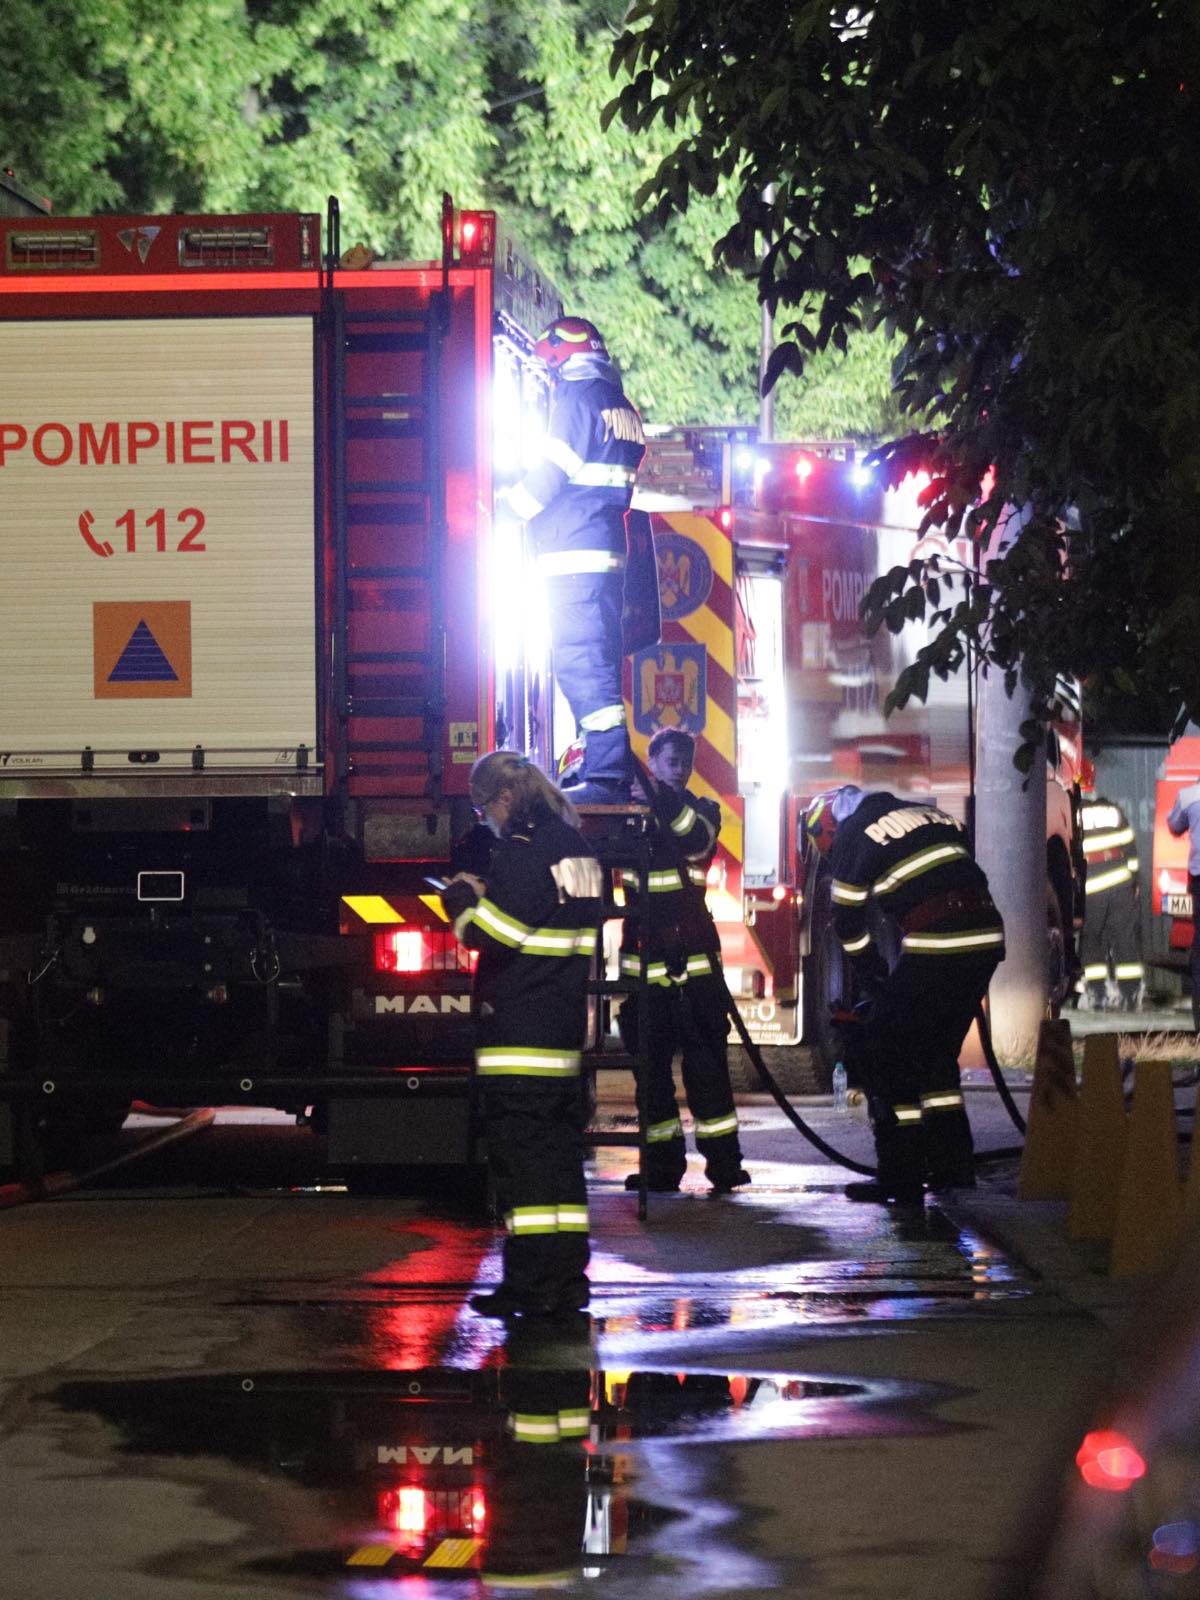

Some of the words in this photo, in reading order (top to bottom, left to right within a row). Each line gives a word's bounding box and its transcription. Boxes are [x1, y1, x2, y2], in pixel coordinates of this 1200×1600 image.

[115, 508, 206, 553] 112
[1171, 898, 1191, 913] MAI
[375, 995, 471, 1013] MAN
